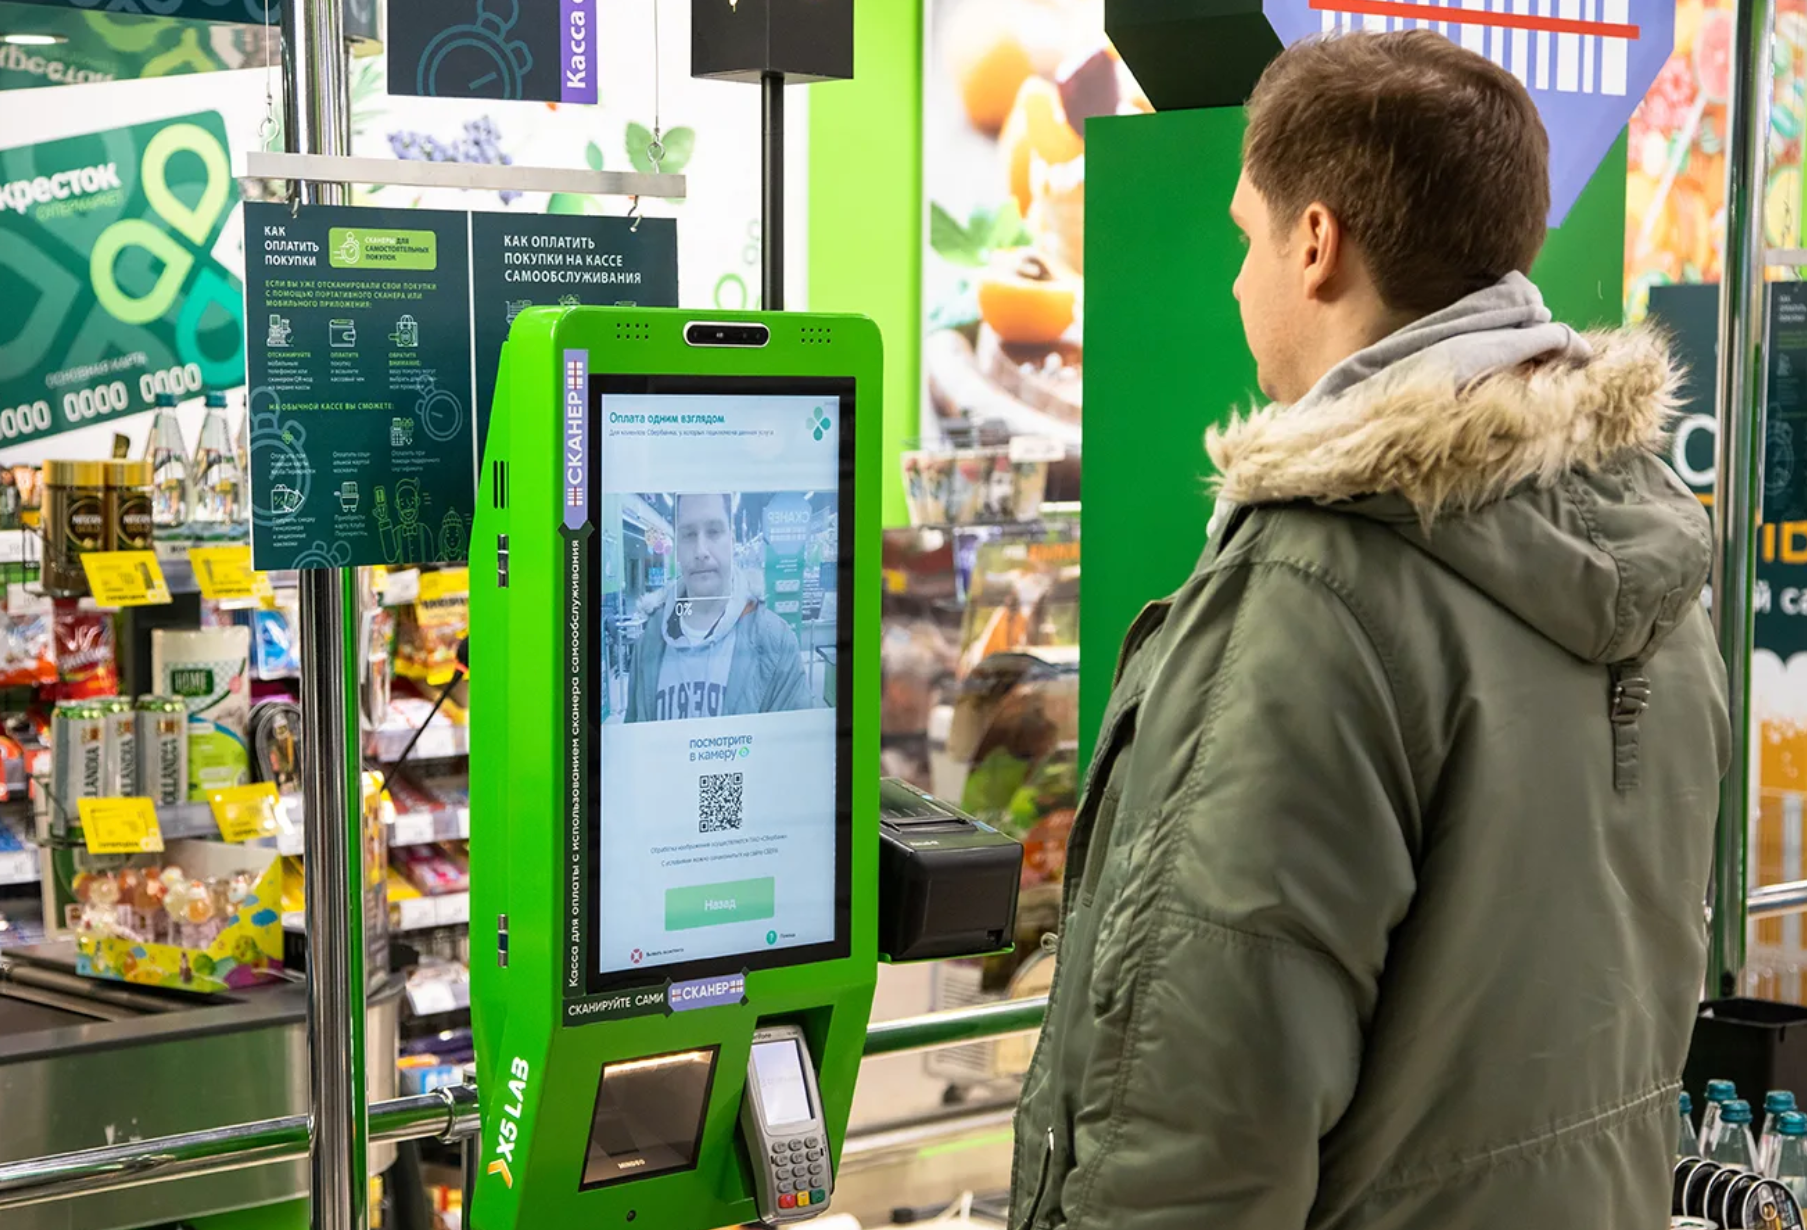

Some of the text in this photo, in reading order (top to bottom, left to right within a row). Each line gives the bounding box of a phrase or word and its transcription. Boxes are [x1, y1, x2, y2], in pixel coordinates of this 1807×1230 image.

[566, 10, 586, 89] Касса
[0, 162, 122, 215] ресток
[264, 225, 286, 237] КАК
[264, 241, 320, 252] ОПЛАТИТЬ
[364, 236, 396, 244] СКАНЕРЫ
[504, 234, 596, 249] КАК ОПЛАТИТЬ
[365, 244, 430, 254] САМОСТОЯТЕЛЬНЫХ
[265, 255, 317, 267] ПОКУПКИ
[365, 253, 397, 261] ПОКУПОК
[504, 252, 623, 267] ПОКУПКИ НА КАССЕ
[504, 269, 642, 284] САМООБСЛУЖИВАНИЯ
[265, 280, 285, 288] ЕСЛИ
[287, 280, 298, 288] ВЫ
[300, 280, 315, 288] УЖЕ
[317, 281, 380, 289] ОТСКАНИРОВАЛИ
[403, 282, 437, 291] ПОКУПКИ
[272, 290, 314, 298] ПОМОЩЬЮ
[315, 291, 372, 299] ПОРТАТИВНОГО
[373, 291, 406, 299] СКАНЕРА
[407, 292, 422, 300] ИЛИ
[265, 299, 318, 308] МОБИЛЬНОГО
[63, 380, 129, 422] 0000
[281, 402, 319, 410] ОБЫЧНОЙ
[345, 402, 356, 410] ВЫ
[357, 402, 395, 410] СМОЖЕТЕ:
[609, 411, 725, 425] Оплата одним взглядом
[567, 391, 583, 485] СКАНЕР
[570, 539, 581, 674] самообслуживания
[675, 602, 693, 617] 0%
[175, 671, 207, 691] HOME
[571, 677, 581, 735] сканера
[689, 734, 753, 749] посмотрите
[689, 748, 737, 762] в камеру
[572, 853, 579, 862] с
[571, 865, 579, 916] оплаты
[704, 898, 737, 912] Назад
[571, 918, 580, 942] для
[568, 944, 579, 987] Касса
[682, 981, 729, 1000] СКАНЕР
[568, 992, 664, 1017] СКАНИРУЙТЕ САМИ
[495, 1056, 530, 1163] X5 LAB
